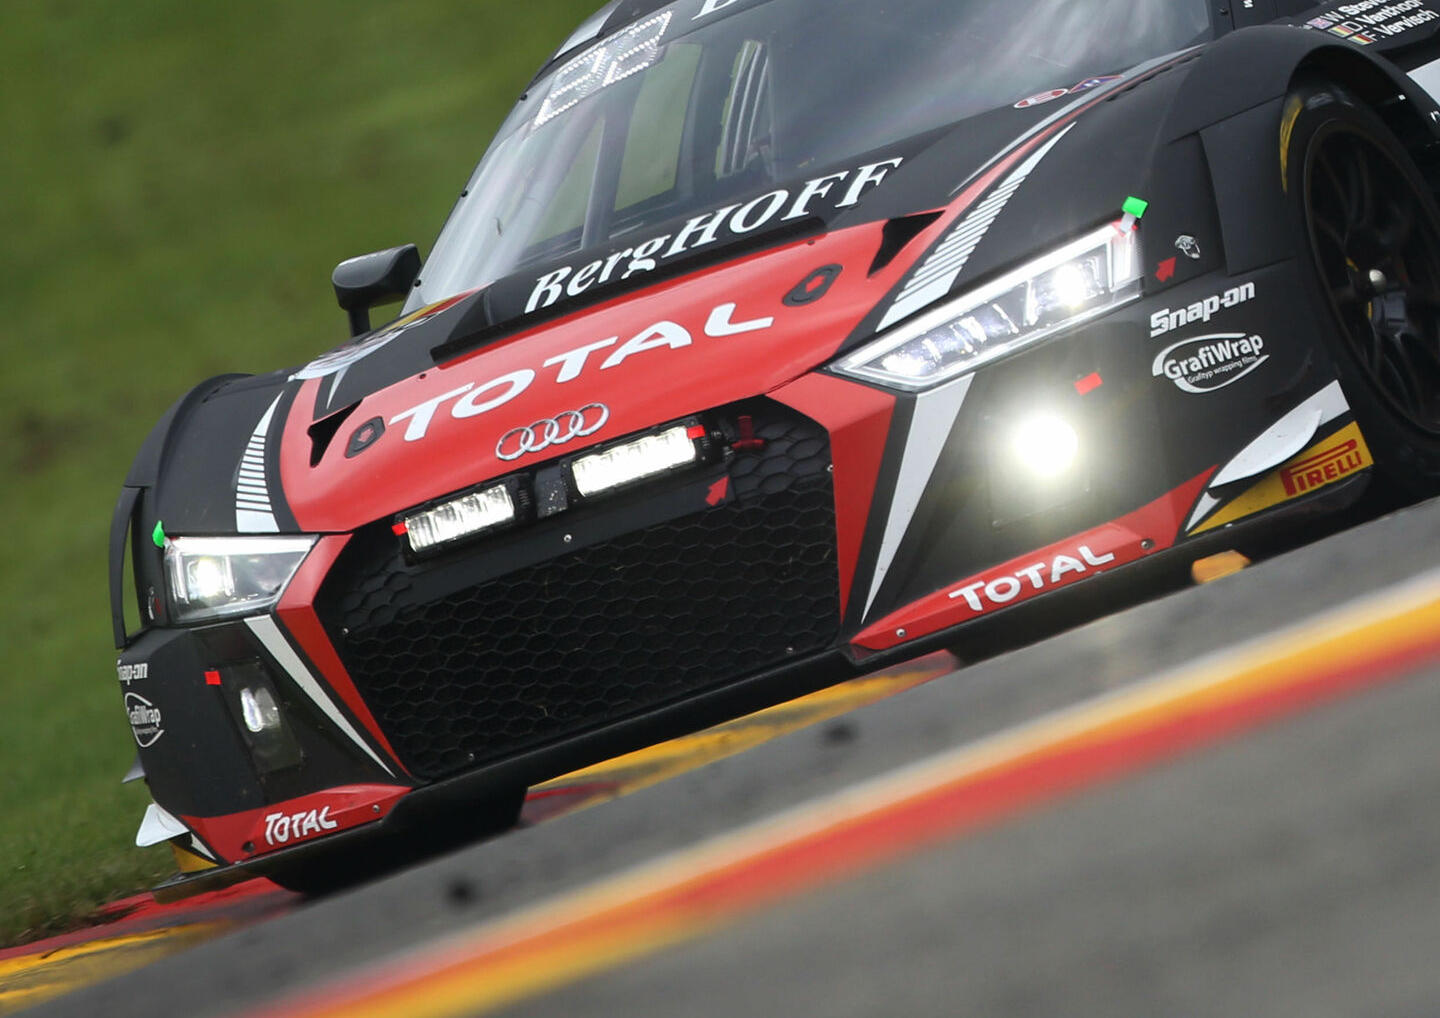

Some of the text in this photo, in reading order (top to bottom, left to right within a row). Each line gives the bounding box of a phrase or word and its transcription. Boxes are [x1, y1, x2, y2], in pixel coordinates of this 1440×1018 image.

[524, 157, 902, 314] BergHOFF
[1150, 282, 1256, 338] Snap-on
[388, 303, 774, 442] TOTAL
[1164, 334, 1264, 380] GrafiWrap
[1279, 438, 1363, 496] PIRELLI
[948, 544, 1115, 612] TOTAL
[117, 659, 149, 686] nap-on
[264, 805, 338, 845] TOTAL
